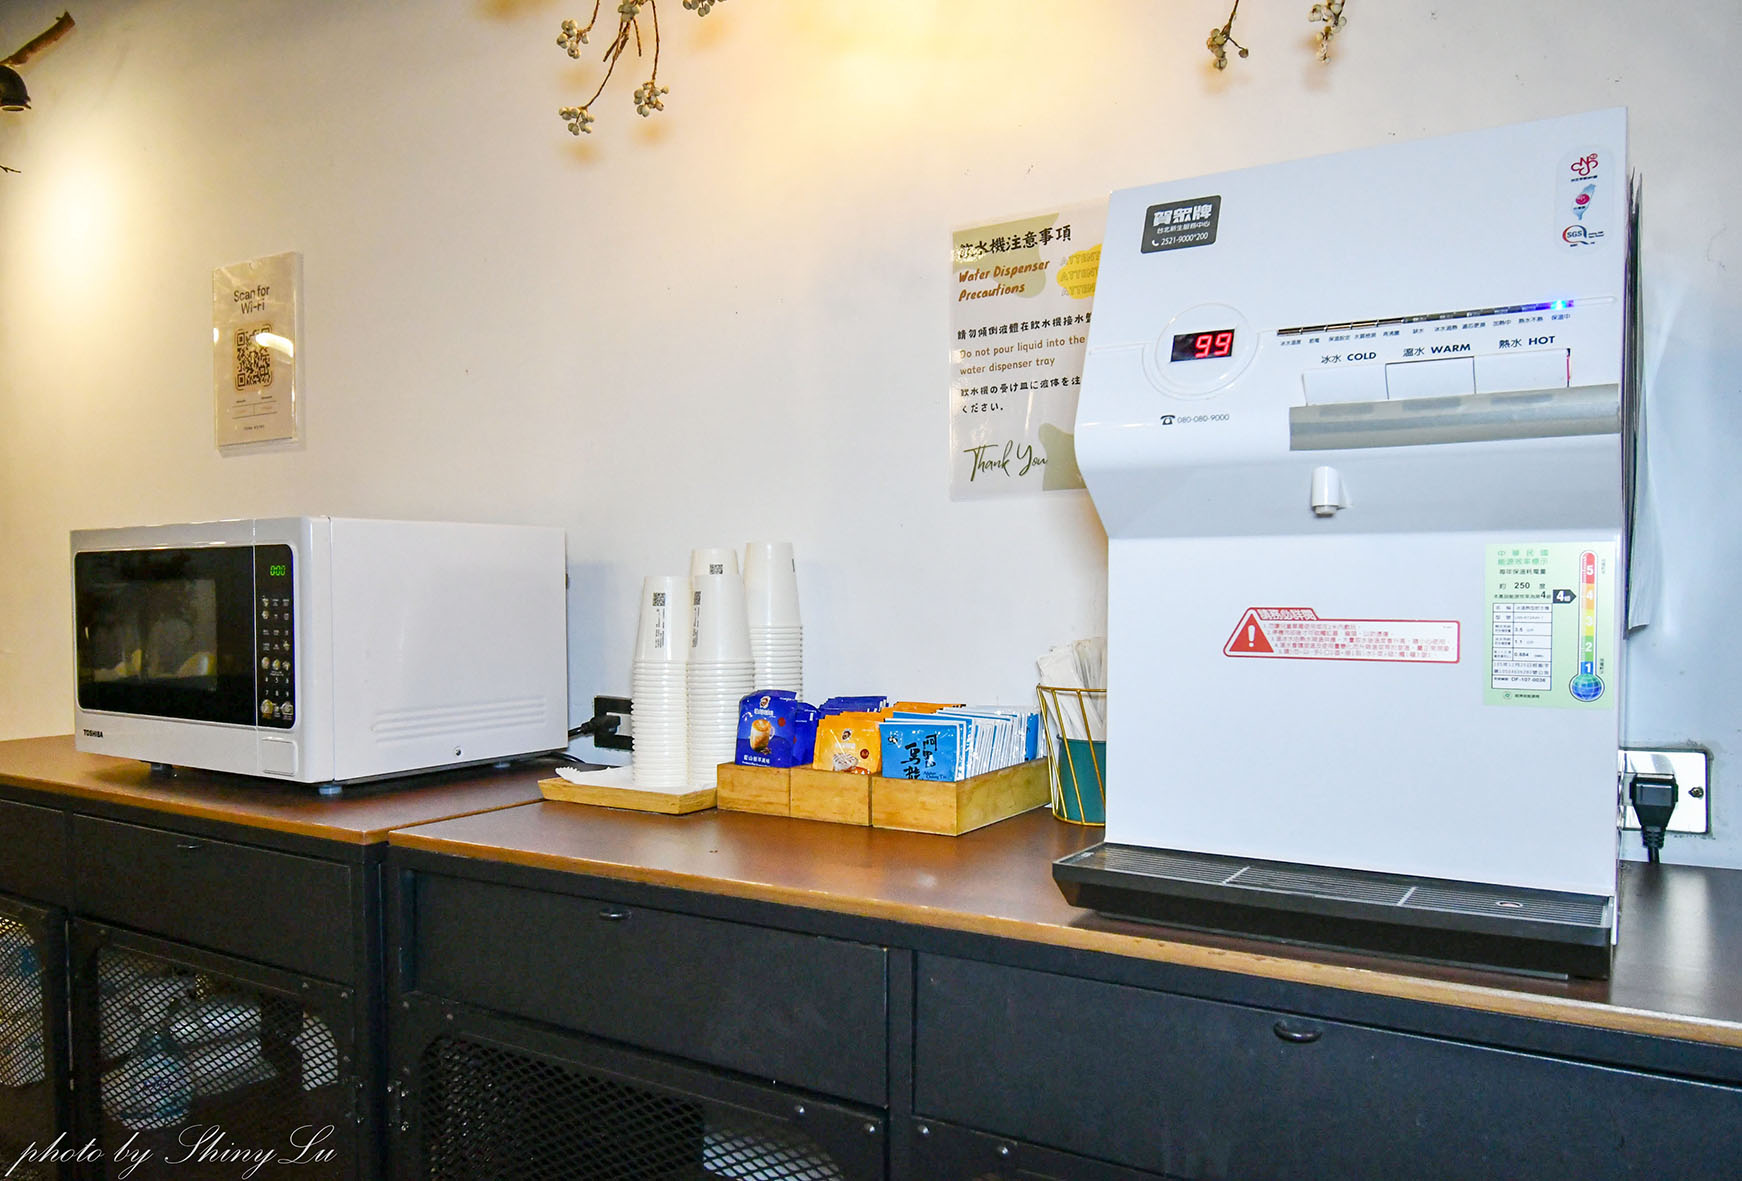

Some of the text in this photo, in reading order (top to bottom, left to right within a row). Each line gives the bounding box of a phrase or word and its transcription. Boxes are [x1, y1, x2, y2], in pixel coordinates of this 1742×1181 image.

[959, 260, 1050, 282] Water Dispenser
[233, 285, 270, 302] Scan for
[958, 283, 1025, 302] Precautions
[959, 335, 1086, 359] Do not pour liquid into the
[1195, 332, 1233, 358] 99
[1431, 343, 1471, 354] WARM
[1498, 335, 1556, 349] 熱水 HOT
[1347, 351, 1377, 361] COLD
[959, 357, 1055, 375] water dispenser tray
[963, 440, 1048, 482] Thank You
[1586, 565, 1593, 575] 5
[1585, 642, 1593, 652] 2
[1585, 663, 1591, 673] 1
